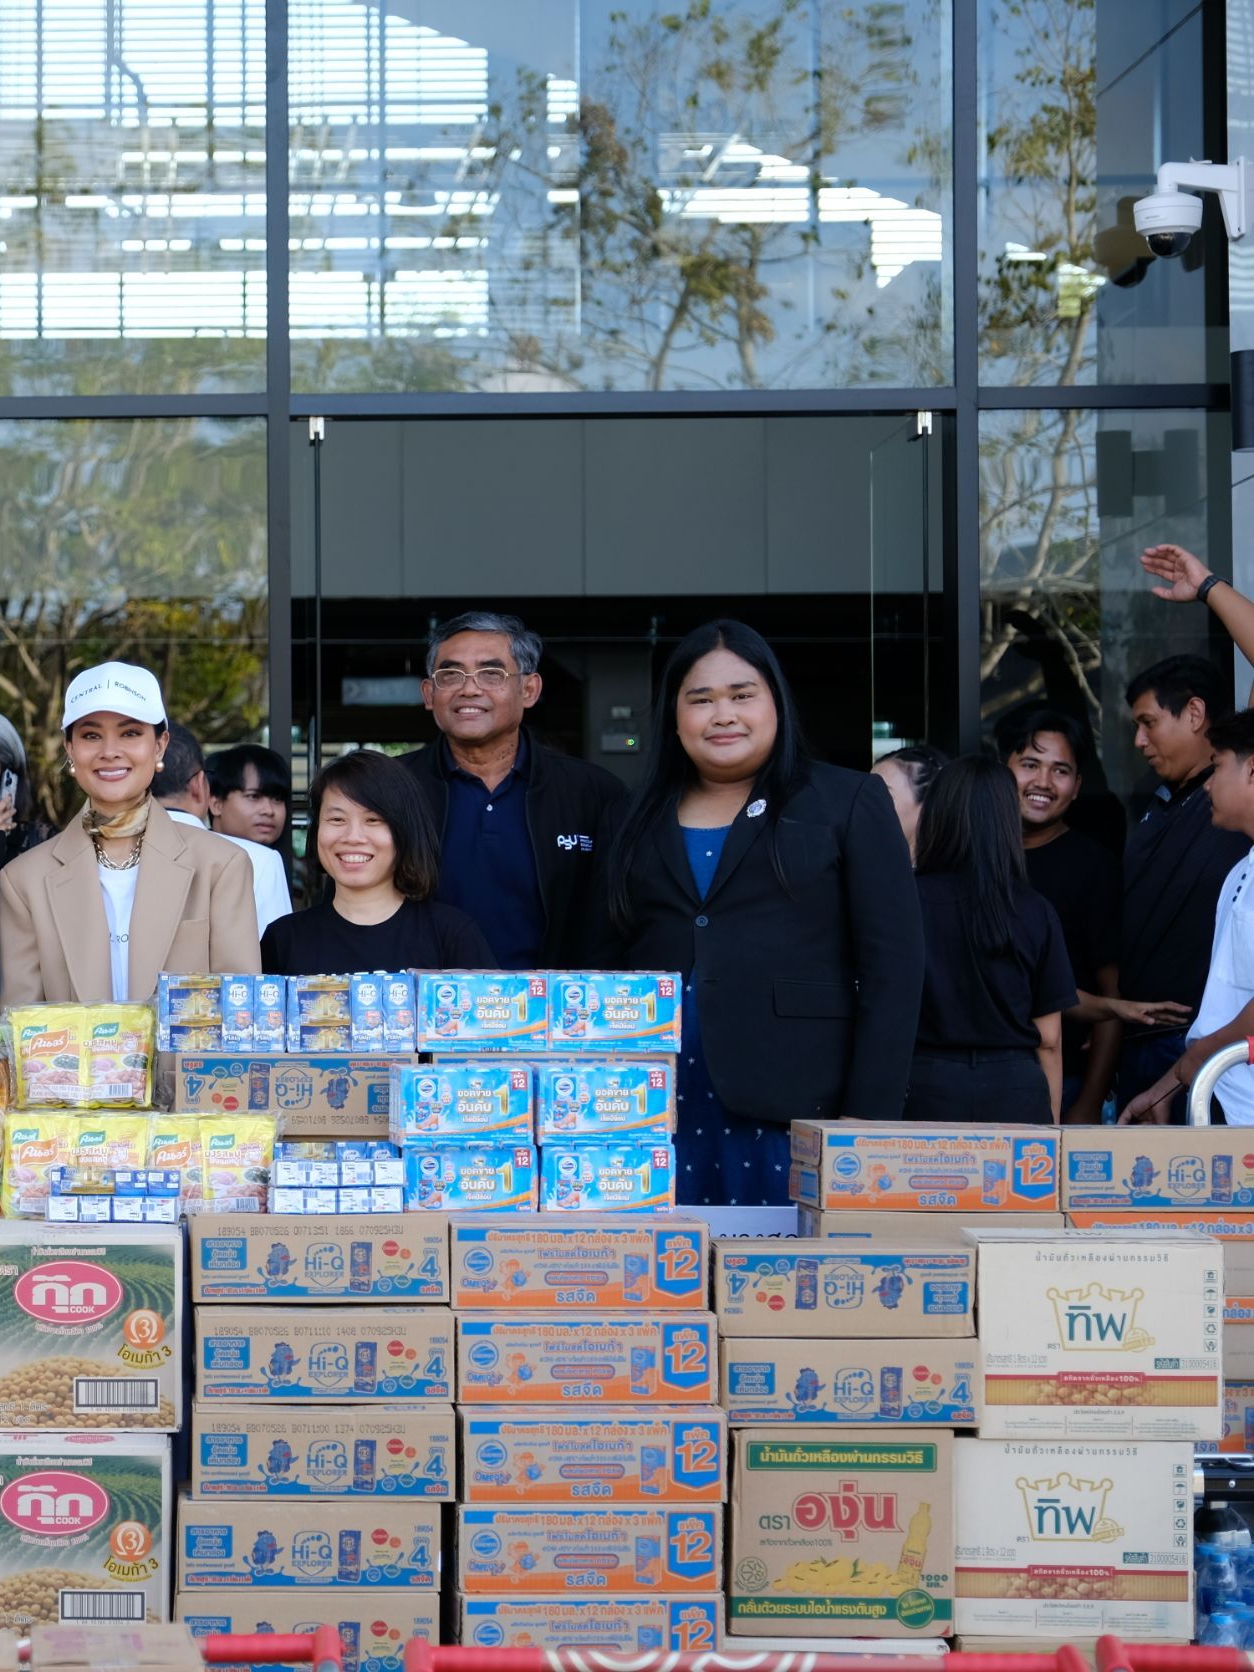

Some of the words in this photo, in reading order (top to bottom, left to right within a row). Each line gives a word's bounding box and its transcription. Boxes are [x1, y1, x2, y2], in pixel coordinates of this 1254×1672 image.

[70, 683, 102, 703] CENTRAL
[114, 681, 146, 701] ROBINSON
[557, 835, 577, 850] PSU
[476, 996, 509, 1005] ยอดขาย
[476, 1007, 510, 1019] อันดับ
[513, 992, 528, 1020] 1
[604, 996, 638, 1006] ยอดขาย
[604, 1007, 639, 1020] อันดับ
[642, 992, 657, 1021] 1
[32, 1034, 64, 1050] คนอร์
[457, 1088, 491, 1098] ยอดขาย
[457, 1100, 492, 1113] อันดับ
[494, 1085, 510, 1114] 1
[594, 1088, 629, 1098] ยอดขาย
[22, 1144, 56, 1159] คนอร์
[156, 1147, 190, 1162] คนอร์
[1016, 1156, 1052, 1184] 12
[1167, 1169, 1206, 1182] Hi-Q
[666, 1237, 690, 1248] แพ็ค
[305, 1257, 345, 1271] Hi-Q
[419, 1255, 441, 1280] 4
[658, 1250, 698, 1281] 12
[555, 1290, 596, 1304] รสจืด
[70, 1306, 95, 1314] COOK
[1065, 1305, 1127, 1341] ทิพ
[673, 1329, 698, 1342] แพ็ค
[117, 1343, 160, 1364] โอเมก้า
[161, 1346, 172, 1357] 3
[665, 1343, 706, 1373] 12
[309, 1357, 349, 1371] Hi-Q
[424, 1355, 445, 1379] 4
[562, 1384, 602, 1397] รสจืด
[834, 1382, 874, 1395] Hi-Q
[307, 1455, 348, 1469] Hi-Q
[676, 1441, 716, 1472] 12
[760, 1446, 924, 1465] น้ำมันถั่วเหลืองผ่านกรรมวิธี
[425, 1454, 445, 1478] 4
[572, 1483, 612, 1497] รสจืด
[759, 1515, 790, 1530] ตรา
[794, 1481, 903, 1542] องุ่น
[1033, 1498, 1096, 1535] ทิพ
[292, 1546, 332, 1559] Hi-Q
[670, 1532, 711, 1562] 12
[409, 1546, 429, 1569] 4
[103, 1556, 147, 1576] โอเมก้า
[148, 1558, 159, 1570] 3
[566, 1573, 606, 1586] รสจืด
[921, 1574, 948, 1582] 1000
